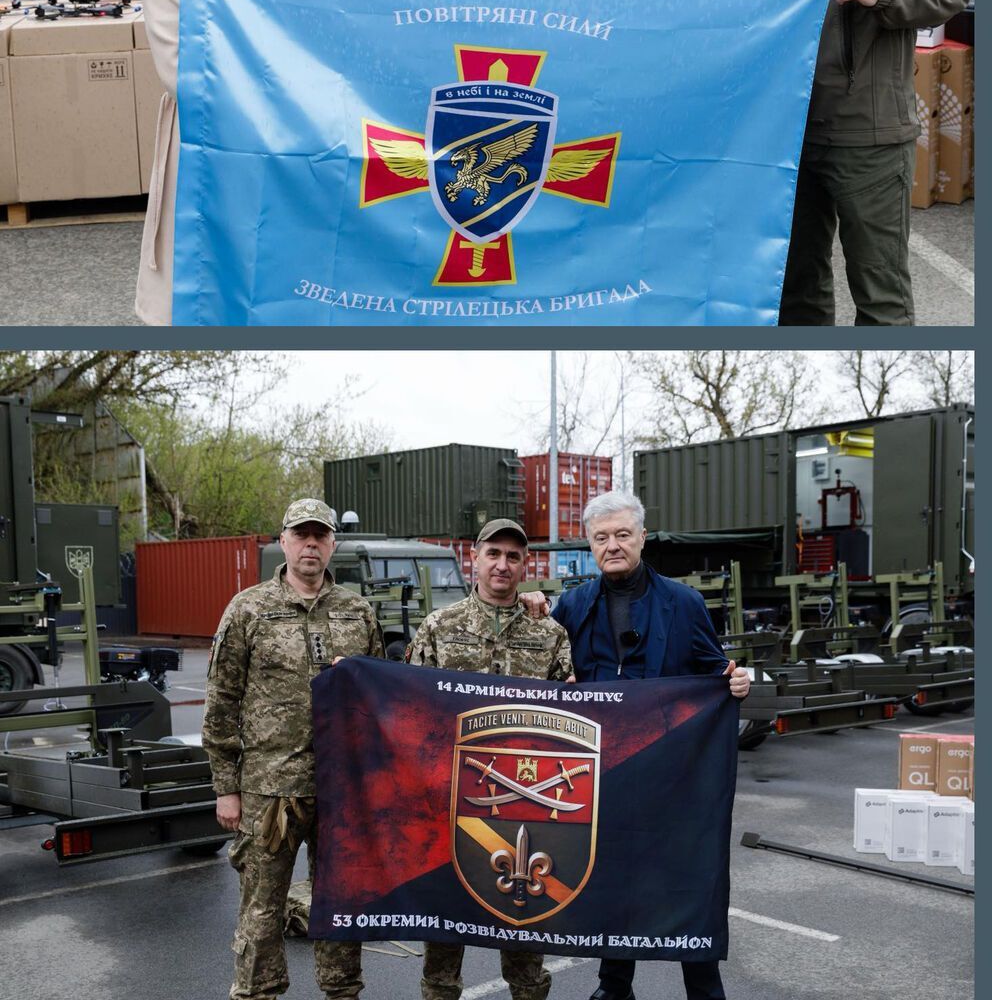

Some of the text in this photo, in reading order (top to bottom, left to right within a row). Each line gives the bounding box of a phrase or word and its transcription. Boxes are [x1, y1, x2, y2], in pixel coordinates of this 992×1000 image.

[393, 6, 537, 26] ПОВІТРЯНІ
[445, 90, 453, 98] в
[457, 85, 482, 97] небі
[494, 87, 509, 97] на
[512, 90, 547, 105] землі
[294, 279, 653, 319] ЗВЕДЕНА СТРІЛЕЦЬКА БРИГАДА
[436, 680, 624, 703] 14 АРМІЙСЬКИЙ КОРПУС
[468, 714, 497, 731] TACITE
[532, 714, 561, 730] TACITE
[908, 744, 932, 754] ergo
[908, 771, 934, 786] QL
[332, 913, 712, 950] 53 ОКРЕМИЙ РОЗВІДУВАЛЬНИЙ БАТАЛЬЙОН
